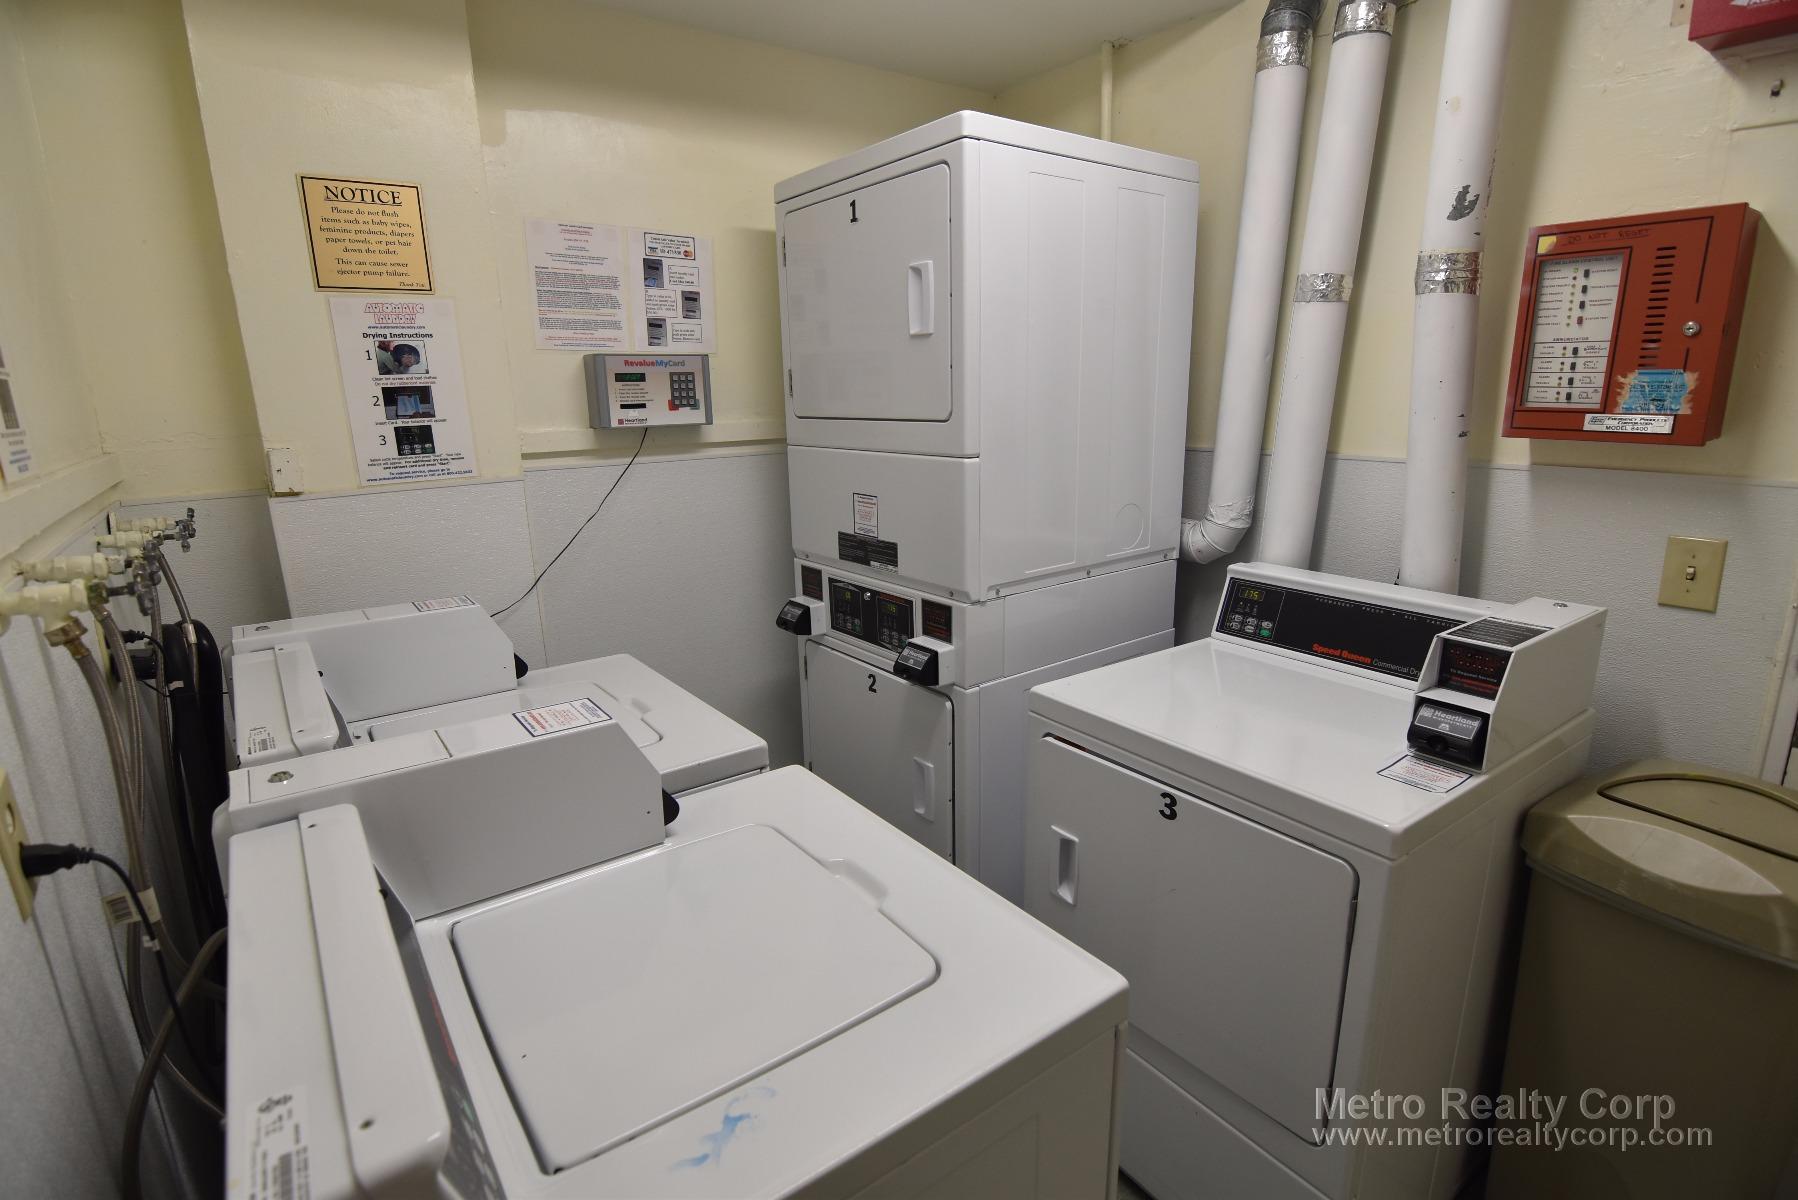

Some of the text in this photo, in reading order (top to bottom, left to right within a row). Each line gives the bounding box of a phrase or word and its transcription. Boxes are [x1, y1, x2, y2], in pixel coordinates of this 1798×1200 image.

[324, 185, 402, 205] NOTICE
[331, 206, 354, 215] Please
[382, 209, 398, 218] flush
[850, 200, 858, 224] 1
[372, 218, 388, 228] baby
[320, 225, 414, 238] feminine products, diapers
[364, 302, 424, 314] AUTOMATIC
[366, 350, 372, 360] 1
[624, 360, 686, 368] RevalueMyCard
[372, 396, 380, 406] 2
[378, 435, 387, 446] 3
[1312, 642, 1341, 656] Speed
[1342, 650, 1372, 664] Queen
[1372, 658, 1408, 674] Commercial
[868, 674, 877, 694] 2
[1434, 710, 1478, 726] Heartland
[1158, 792, 1178, 820] 3
